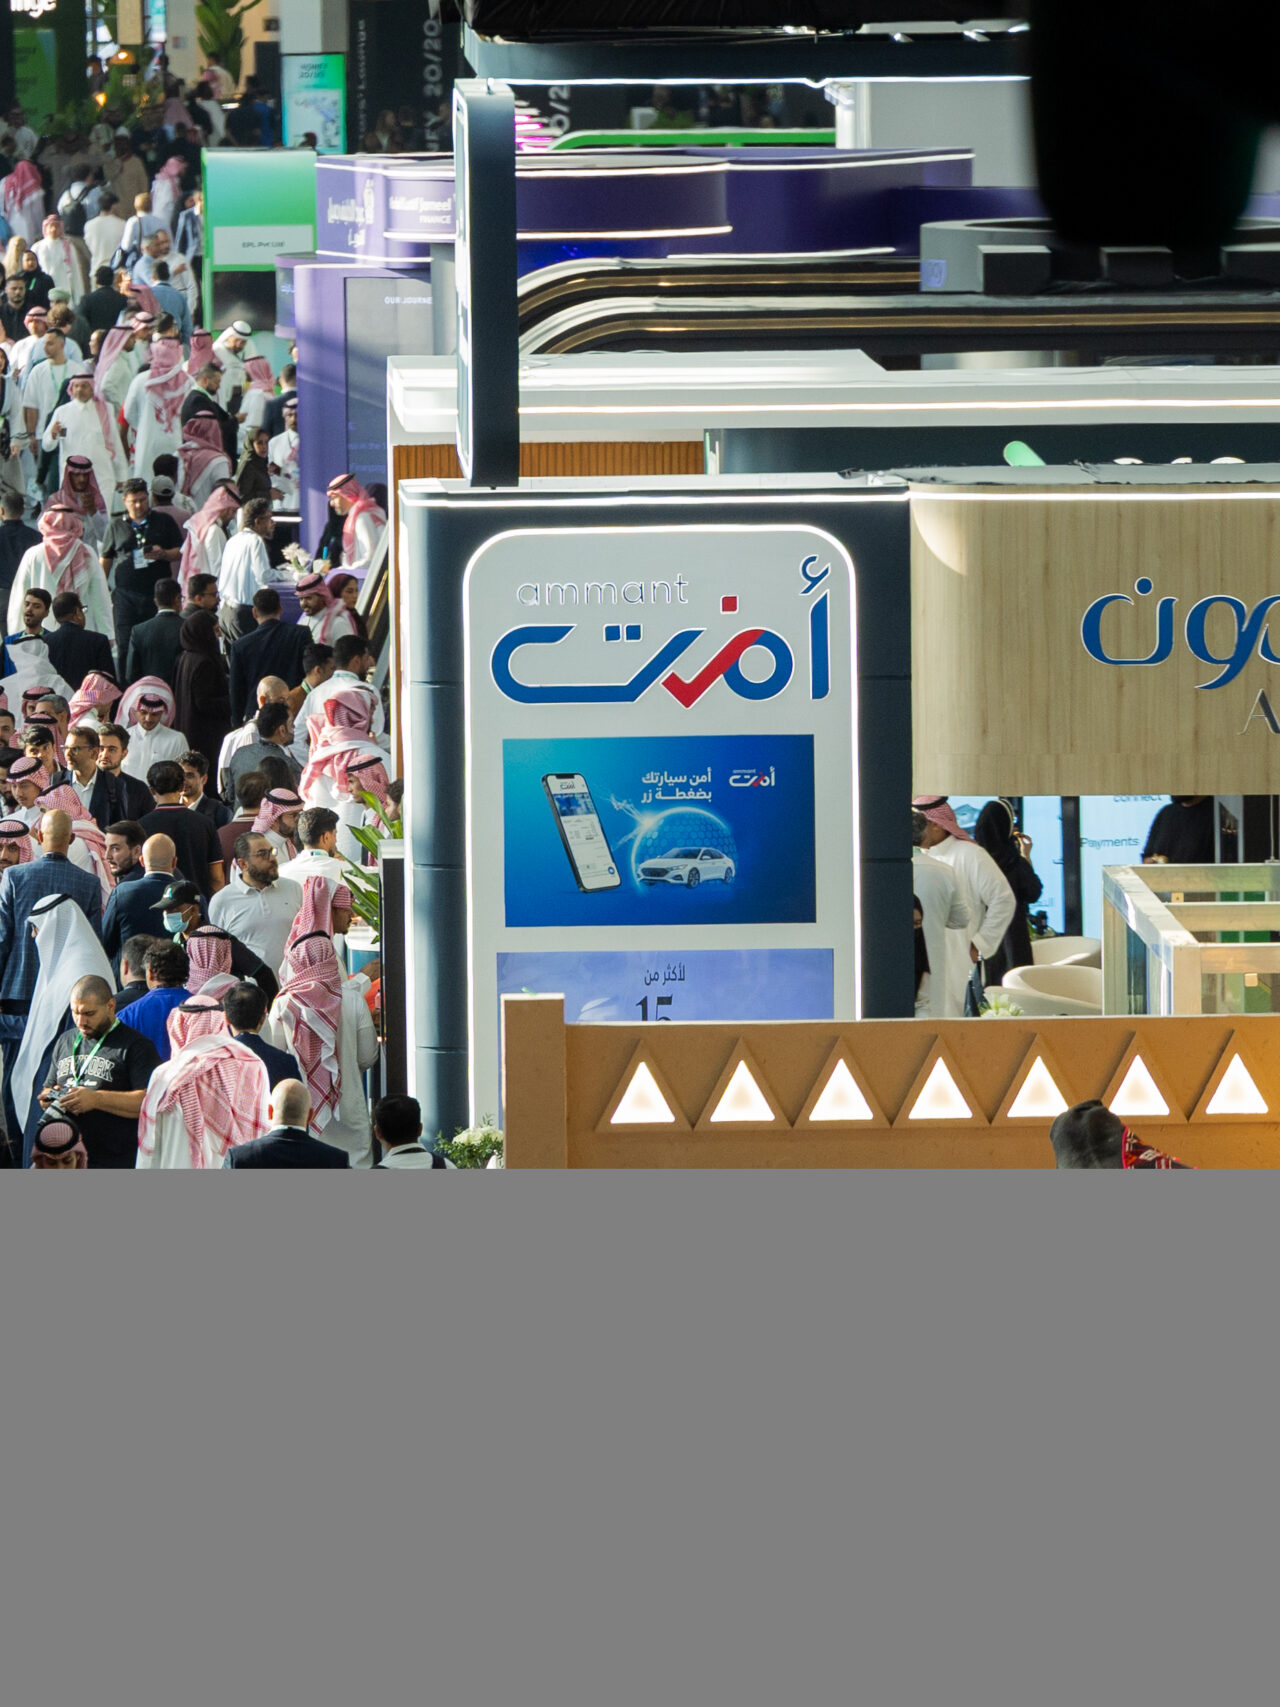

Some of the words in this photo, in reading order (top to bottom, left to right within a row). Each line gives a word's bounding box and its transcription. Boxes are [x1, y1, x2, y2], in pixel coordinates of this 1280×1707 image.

[517, 573, 688, 605] ammant
[641, 770, 687, 787] سيارتك
[688, 766, 712, 787] أمن
[640, 789, 652, 804] زر
[1080, 836, 1141, 851] Payments
[644, 969, 660, 987] من
[662, 961, 686, 987] لأكثر
